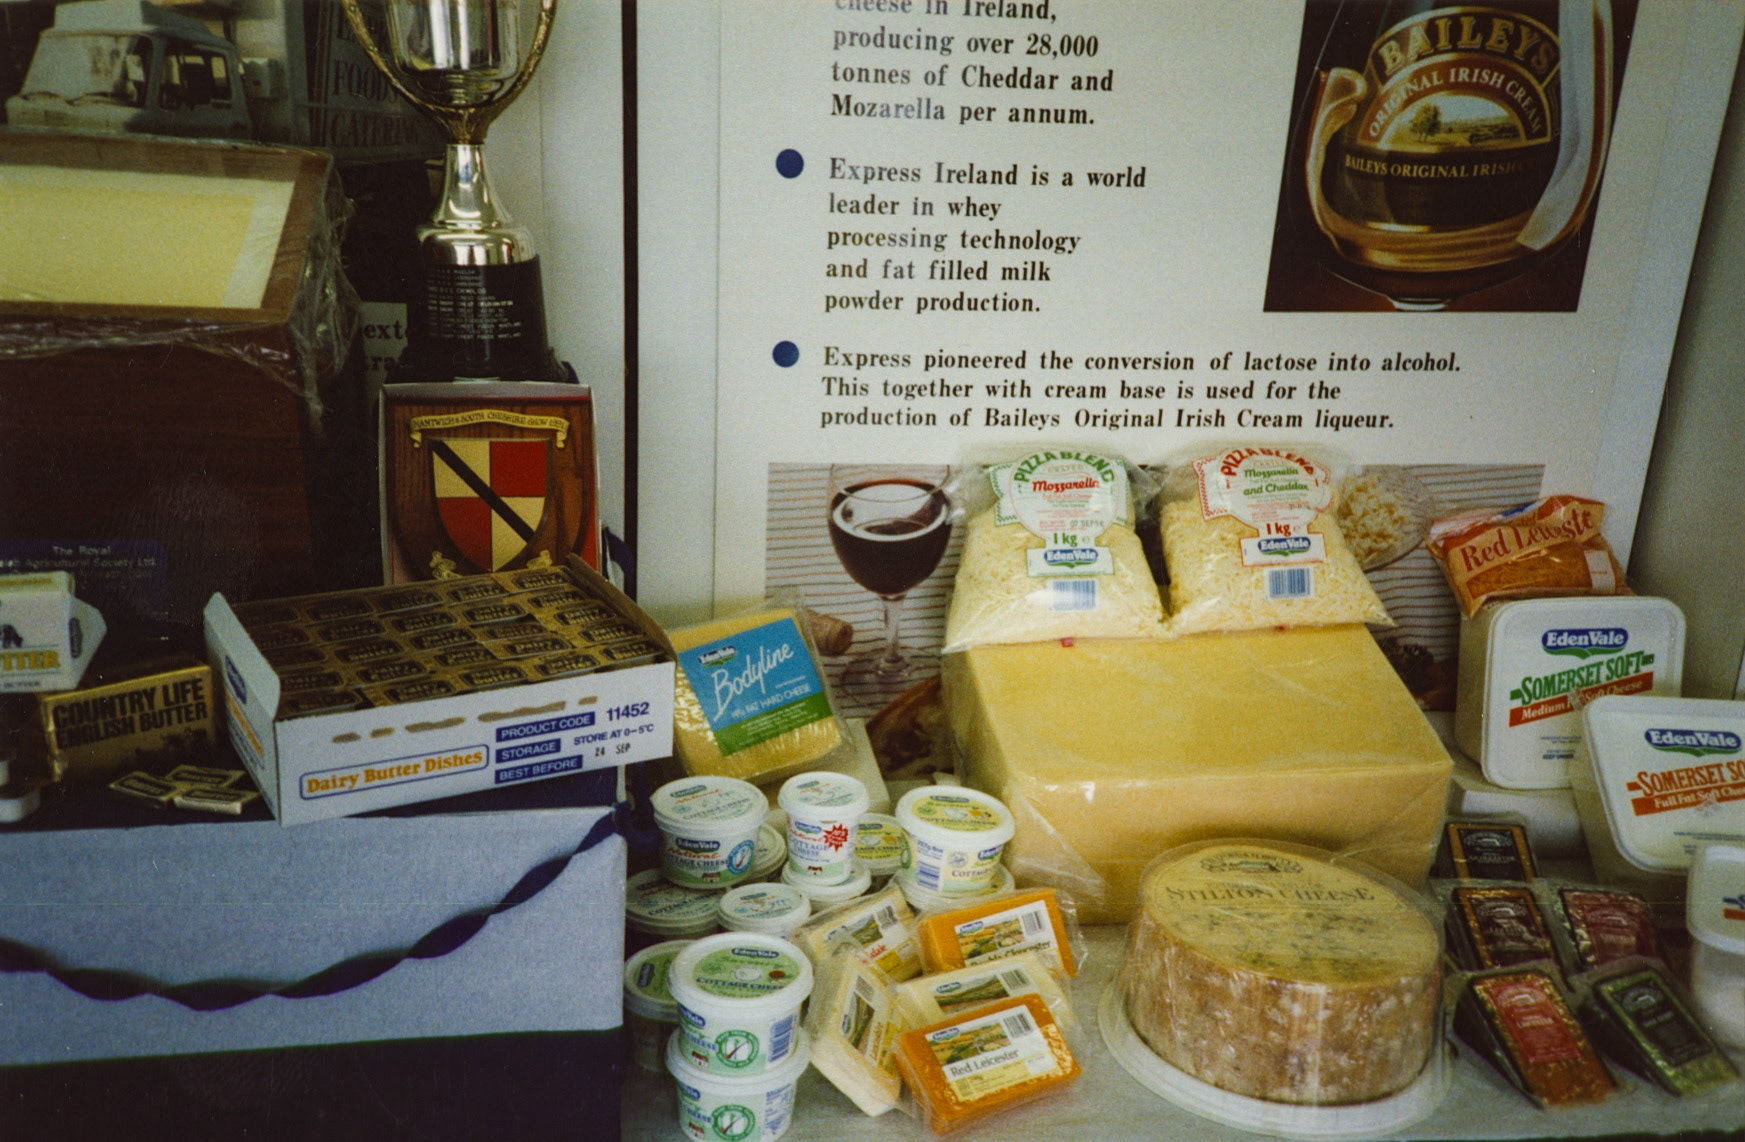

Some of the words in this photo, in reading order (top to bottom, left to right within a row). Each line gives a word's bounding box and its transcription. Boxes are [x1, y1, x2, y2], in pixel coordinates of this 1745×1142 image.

[835, 0, 913, 14] cheese
[925, 0, 948, 16] in
[963, 0, 1057, 24] Ireland,
[833, 25, 955, 56] producing
[966, 37, 1015, 55] over
[1025, 33, 1099, 59] 28,000
[1381, 15, 1556, 75] BAILEYS
[831, 61, 911, 85] tonnes
[923, 63, 949, 87] of
[961, 64, 1060, 90] Cheddar
[1070, 68, 1114, 92] and
[830, 93, 946, 120] Mozarella
[959, 105, 997, 126] per
[1008, 107, 1095, 125] annum.
[1369, 70, 1444, 138] ORIGINAL
[1449, 66, 1503, 89] IRISH
[1505, 80, 1543, 134] CREAM
[829, 157, 921, 185] Express
[935, 162, 1018, 186] Ireland
[1031, 164, 1049, 186] is
[1061, 171, 1074, 187] a
[1086, 166, 1147, 188] world
[1345, 154, 1388, 175] BAILEYS
[1390, 163, 1469, 178] ORIGINAL
[829, 192, 900, 215] leader
[912, 196, 934, 217] in
[947, 195, 1002, 222] whey
[826, 227, 948, 253] processing
[960, 228, 1081, 255] technology
[825, 257, 868, 279] and
[882, 258, 915, 280] fat
[929, 259, 988, 281] filled
[1001, 260, 1051, 282] milk
[824, 289, 904, 313] powder
[916, 290, 1040, 315] production.
[363, 320, 408, 340] ext
[824, 346, 911, 371] Express
[924, 348, 1027, 372] pioneered
[1040, 350, 1074, 370] the
[1084, 350, 1195, 371] conversion
[1209, 351, 1233, 371] of
[1243, 351, 1318, 371] lactose
[1328, 351, 1371, 372] into
[1381, 351, 1461, 372] alcohol.
[821, 376, 869, 397] This
[882, 377, 974, 400] together
[985, 379, 1031, 398] with
[1044, 385, 1107, 399] cream
[1120, 379, 1166, 399] base
[1177, 380, 1194, 399] is
[1206, 379, 1255, 400] used
[1266, 380, 1298, 400] for
[1308, 380, 1341, 400] the
[820, 406, 937, 429] production
[949, 407, 973, 427] of
[984, 407, 1060, 431] Baileys
[1074, 408, 1164, 431] Original
[1176, 408, 1226, 428] Irish
[1237, 409, 1303, 428] Cream
[1315, 409, 1394, 432] liqueur.
[1014, 451, 1057, 482] PIZZA
[1060, 451, 1115, 482] BLEND
[1220, 448, 1259, 476] PIZZA
[1032, 476, 1100, 493] Mozzarella
[1243, 485, 1263, 496] and
[1062, 532, 1078, 547] kg
[1274, 522, 1292, 537] kg
[52, 545, 73, 555] The
[79, 545, 111, 556] Royal
[1047, 549, 1097, 562] EdenVale
[1260, 537, 1309, 552] EdenVale
[1459, 529, 1511, 573] Red
[25, 558, 90, 569] Agricultural
[93, 558, 133, 569] Society
[1546, 630, 1625, 647] EdenVale
[711, 643, 795, 722] Bodyline
[1521, 660, 1604, 706] SOMERSET
[1606, 650, 1645, 681] SOFT
[1606, 679, 1643, 696] Cheese
[53, 686, 156, 729] COUNTRY
[163, 678, 204, 702] LIFE
[1521, 701, 1565, 721] Medium
[55, 715, 137, 750] ENGLISH
[140, 702, 209, 734] BUTTER
[501, 720, 558, 740] PRODUCT
[559, 715, 591, 730] CODE
[606, 702, 650, 721] 11452
[501, 741, 557, 761] STORAGE
[573, 732, 608, 747] STORE
[610, 729, 623, 739] AT
[616, 742, 631, 755] SEP
[1649, 730, 1738, 748] EdenVale
[306, 774, 360, 794] Dairy
[363, 761, 421, 783] Butter
[424, 751, 483, 773] Dishes
[500, 768, 530, 780] BEST
[532, 758, 579, 776] BEFORE
[1637, 763, 1727, 797] SOMERSET
[1654, 795, 1678, 809] Full
[1678, 792, 1697, 804] Fat
[678, 838, 720, 850] EdenVale
[1165, 886, 1274, 902] STILTON
[1279, 886, 1376, 902] CHEESE
[734, 948, 778, 958] EdenVale
[697, 977, 748, 989] COTTAGE
[951, 1064, 973, 1077] Red
[974, 1049, 1019, 1070] Leicester
